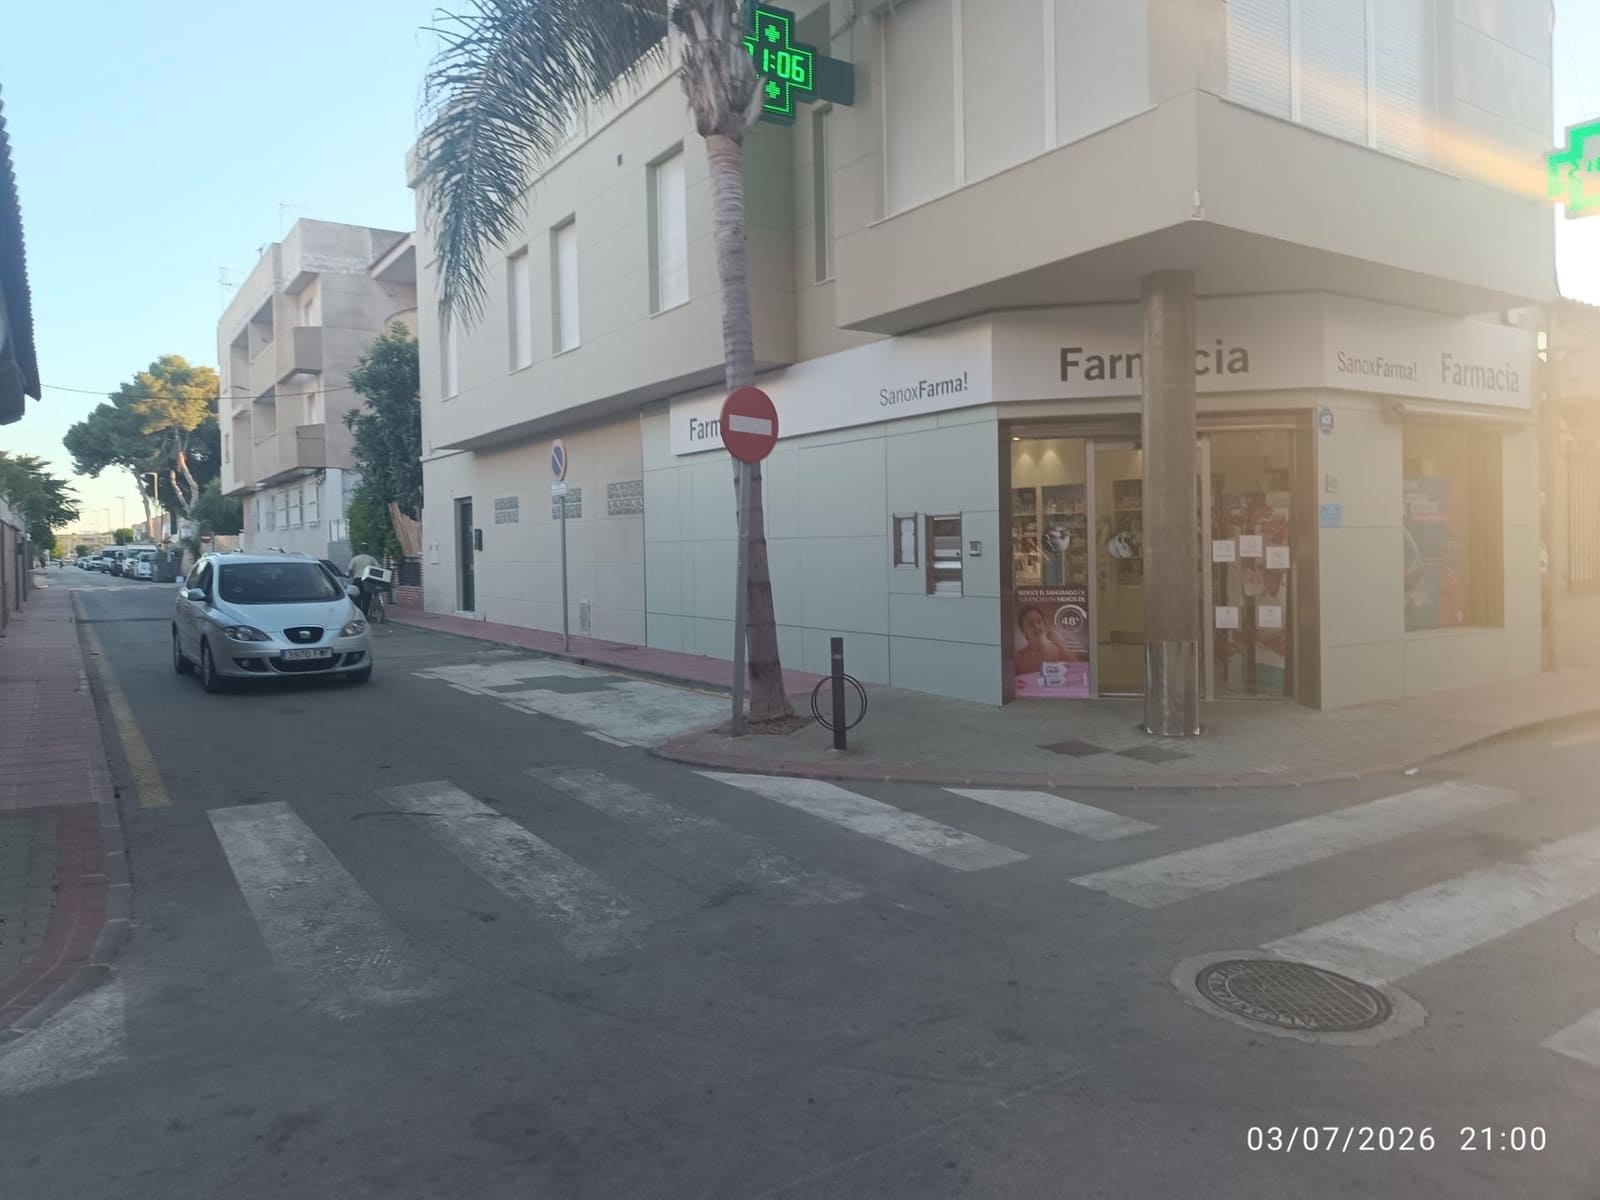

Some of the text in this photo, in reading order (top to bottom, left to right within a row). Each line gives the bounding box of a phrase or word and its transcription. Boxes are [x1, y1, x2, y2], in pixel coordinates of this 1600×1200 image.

[1060, 339, 1250, 382] Farcia
[1337, 351, 1418, 382] SanoxFarma!
[1441, 353, 1520, 393] Farmacia
[880, 371, 968, 407] SanoxFarma!
[690, 417, 721, 441] Farm
